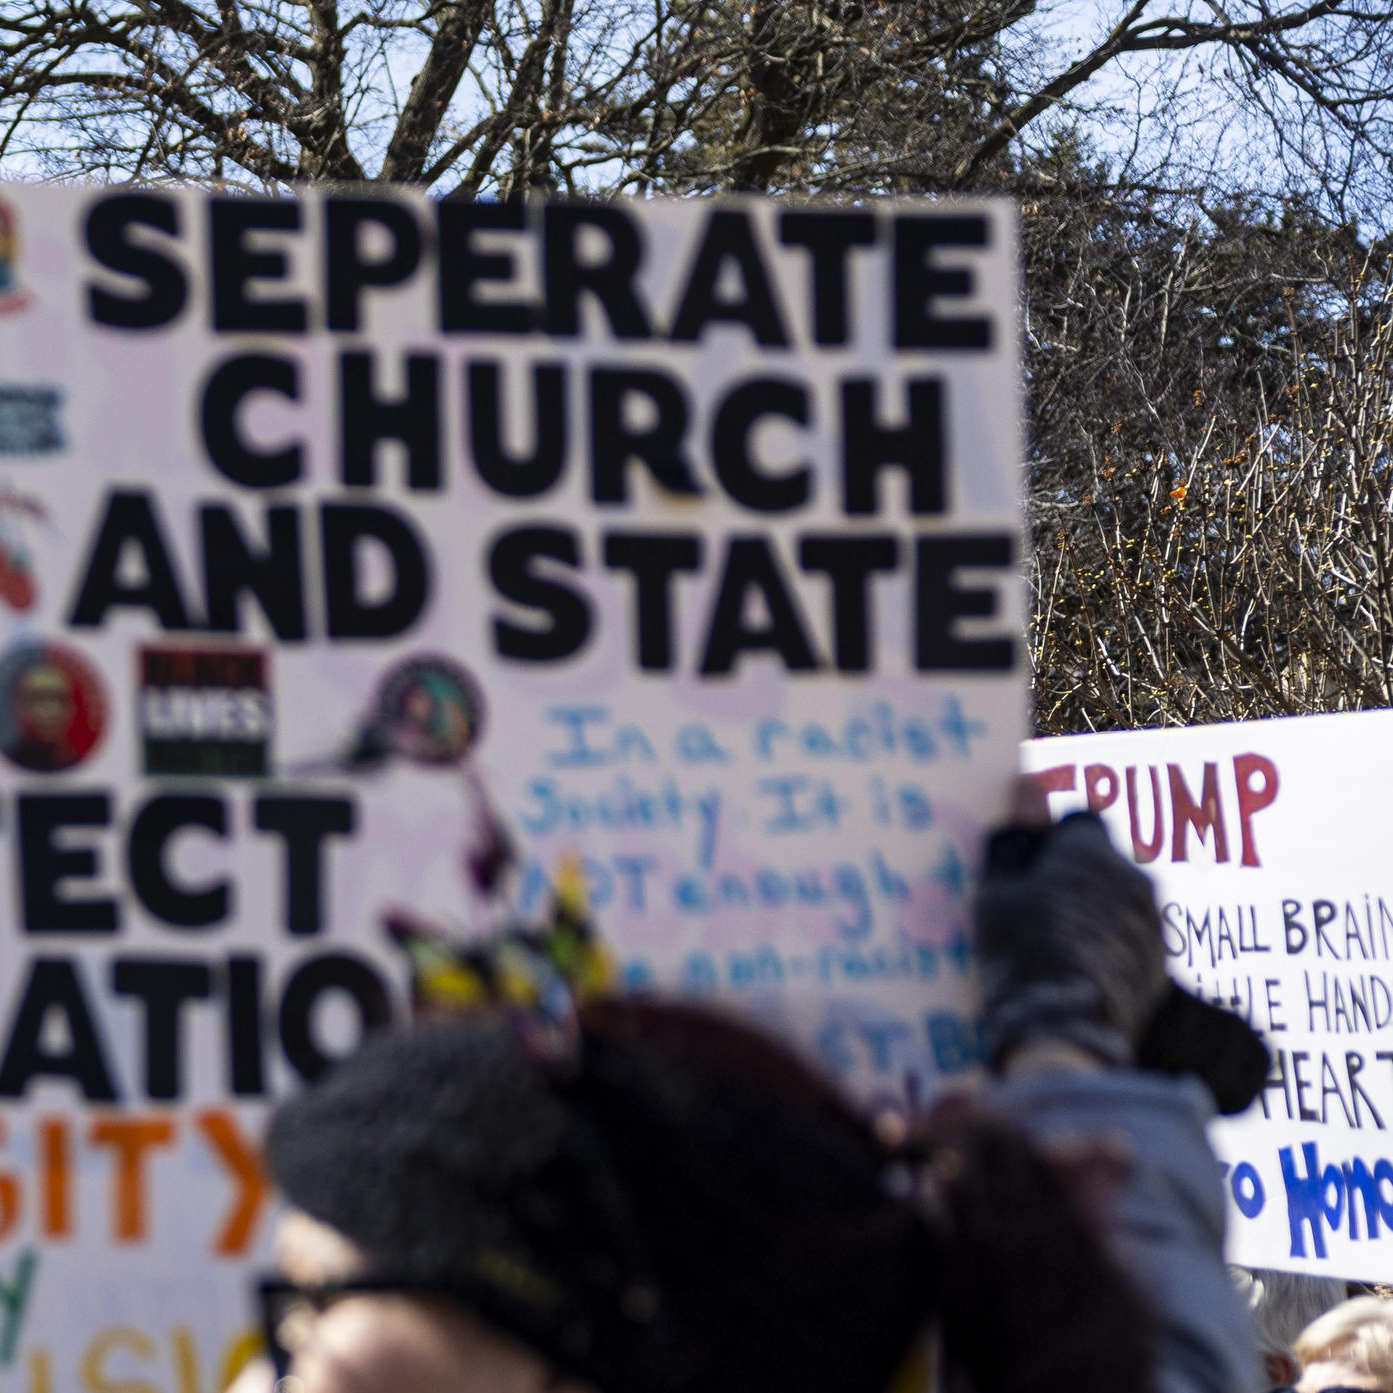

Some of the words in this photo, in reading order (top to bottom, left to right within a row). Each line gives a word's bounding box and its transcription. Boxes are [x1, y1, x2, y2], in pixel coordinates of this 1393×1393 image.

[80, 194, 996, 353] SEPERATE
[197, 348, 951, 517] CHURCH
[67, 483, 436, 645] AND
[488, 521, 1019, 677] STATE
[543, 704, 657, 769] In
[674, 722, 731, 764] a
[755, 696, 989, 762] racist
[758, 775, 842, 832] It
[871, 781, 936, 831] is
[1161, 902, 1272, 968] SMALL
